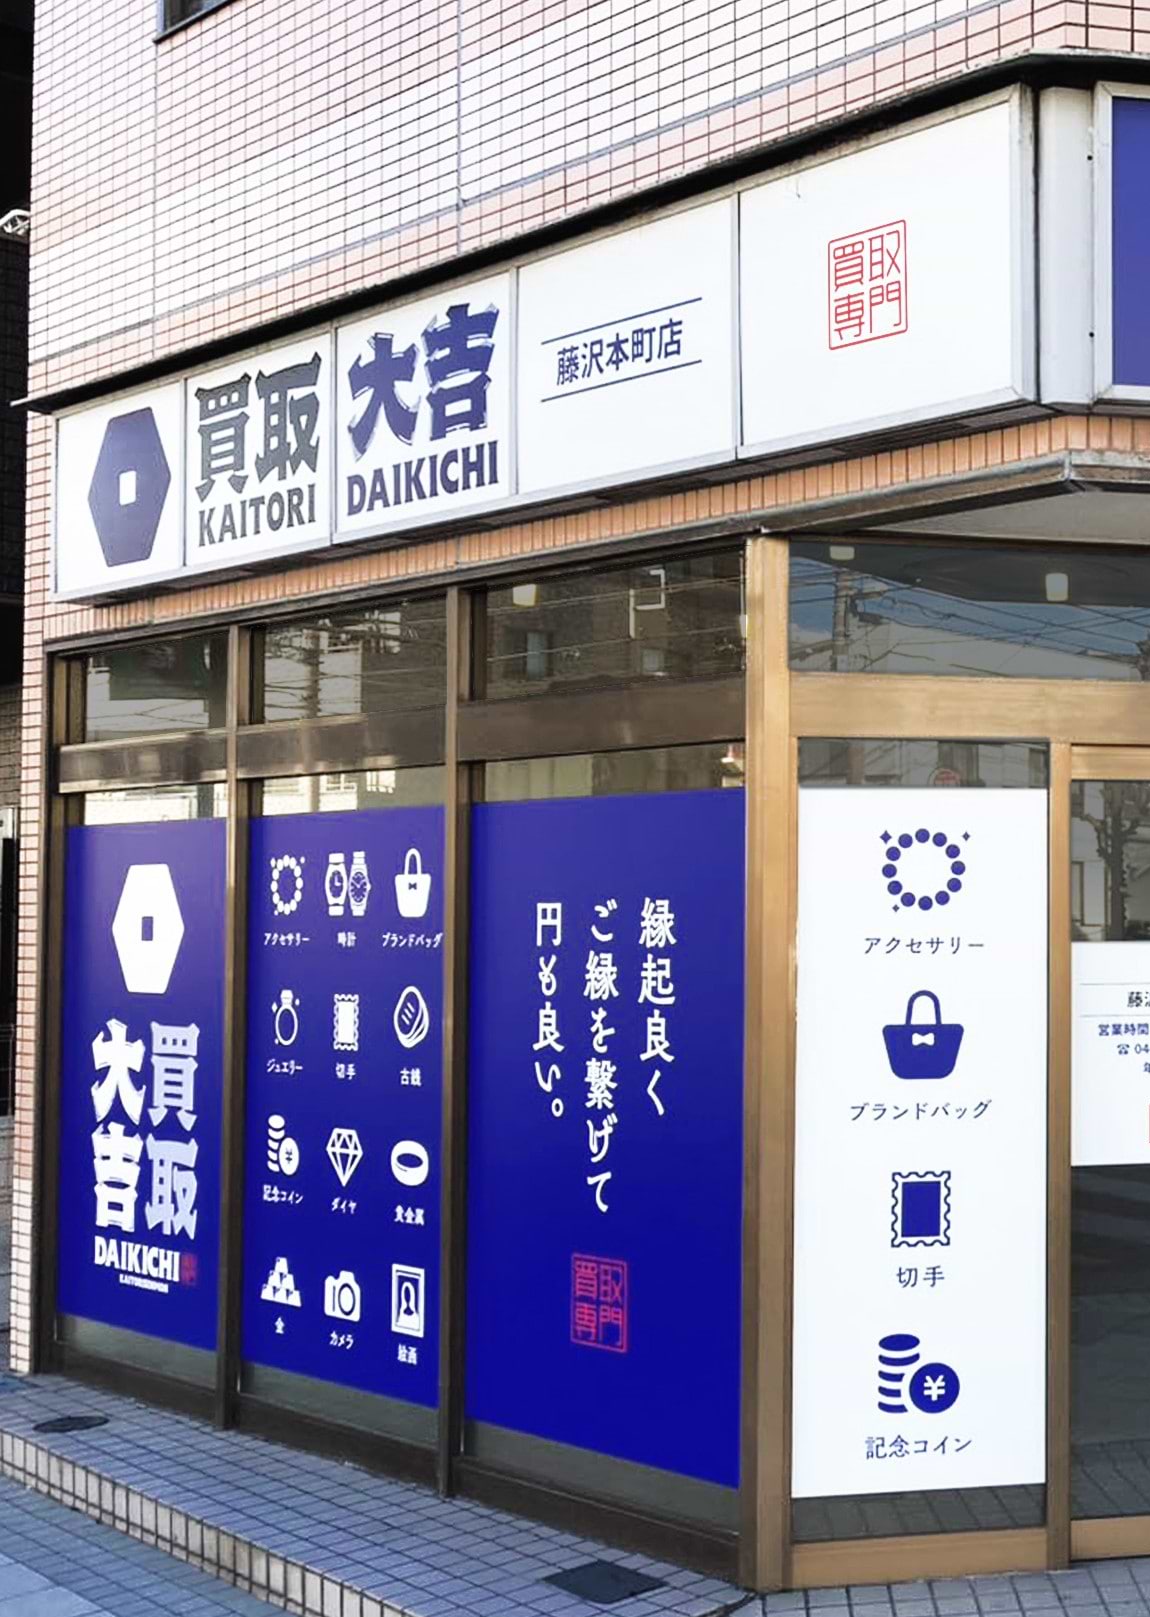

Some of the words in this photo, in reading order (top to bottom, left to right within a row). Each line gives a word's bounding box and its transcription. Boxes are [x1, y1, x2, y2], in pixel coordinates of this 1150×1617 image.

[833, 230, 901, 292] 買取
[556, 317, 683, 386] 藤沢本町店
[347, 440, 499, 516] DAIKICHI
[198, 483, 317, 547] KAITORI
[264, 932, 310, 947] アクセサリー
[382, 931, 444, 948] ブランドバッグ
[864, 936, 985, 955] アクセサリー
[532, 902, 565, 1118] 円も良い。
[638, 897, 677, 1117] 縁起良く
[266, 1058, 304, 1076] ジュエリー
[583, 899, 619, 1213] ご縁を繋げて
[91, 1018, 147, 1233] 大吉
[145, 1021, 200, 1240] 買取
[849, 1100, 993, 1121] ブランドバッグ
[94, 1235, 180, 1282] DAIKICHI
[895, 1265, 945, 1289] 切手
[865, 1434, 973, 1460] 記念コイン
